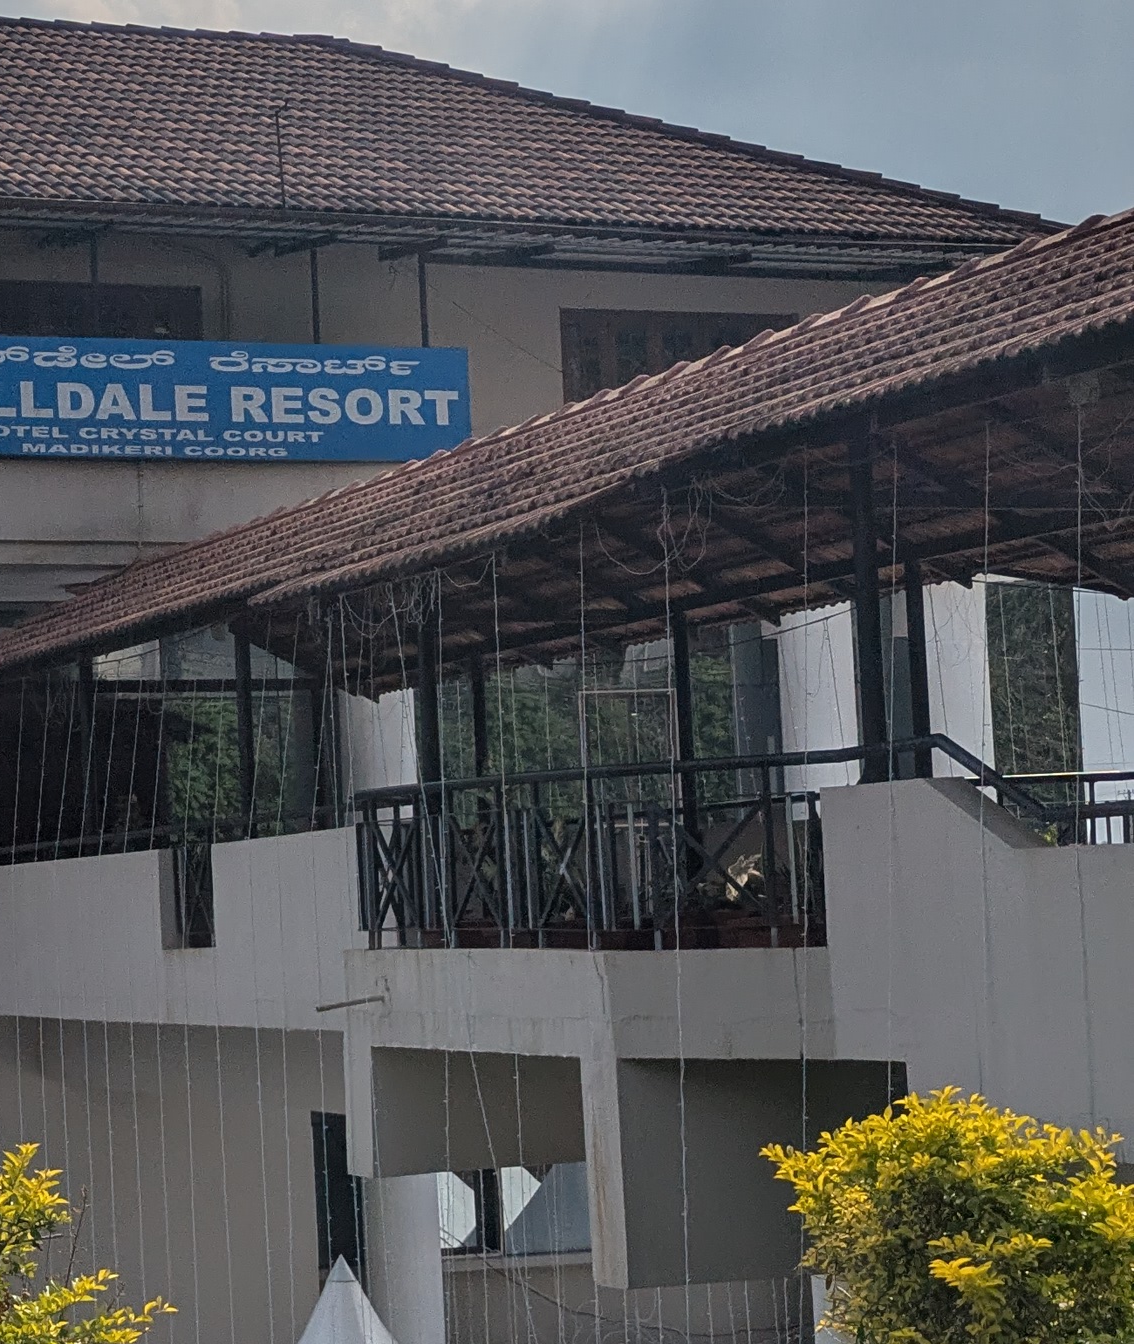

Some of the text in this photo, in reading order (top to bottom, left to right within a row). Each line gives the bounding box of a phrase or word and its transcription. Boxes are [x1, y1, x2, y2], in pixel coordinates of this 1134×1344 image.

[230, 385, 460, 427] RESORT
[78, 427, 214, 442] CRYSTAL
[222, 429, 325, 443] COURT
[22, 442, 289, 458] MADIKERI COORG
